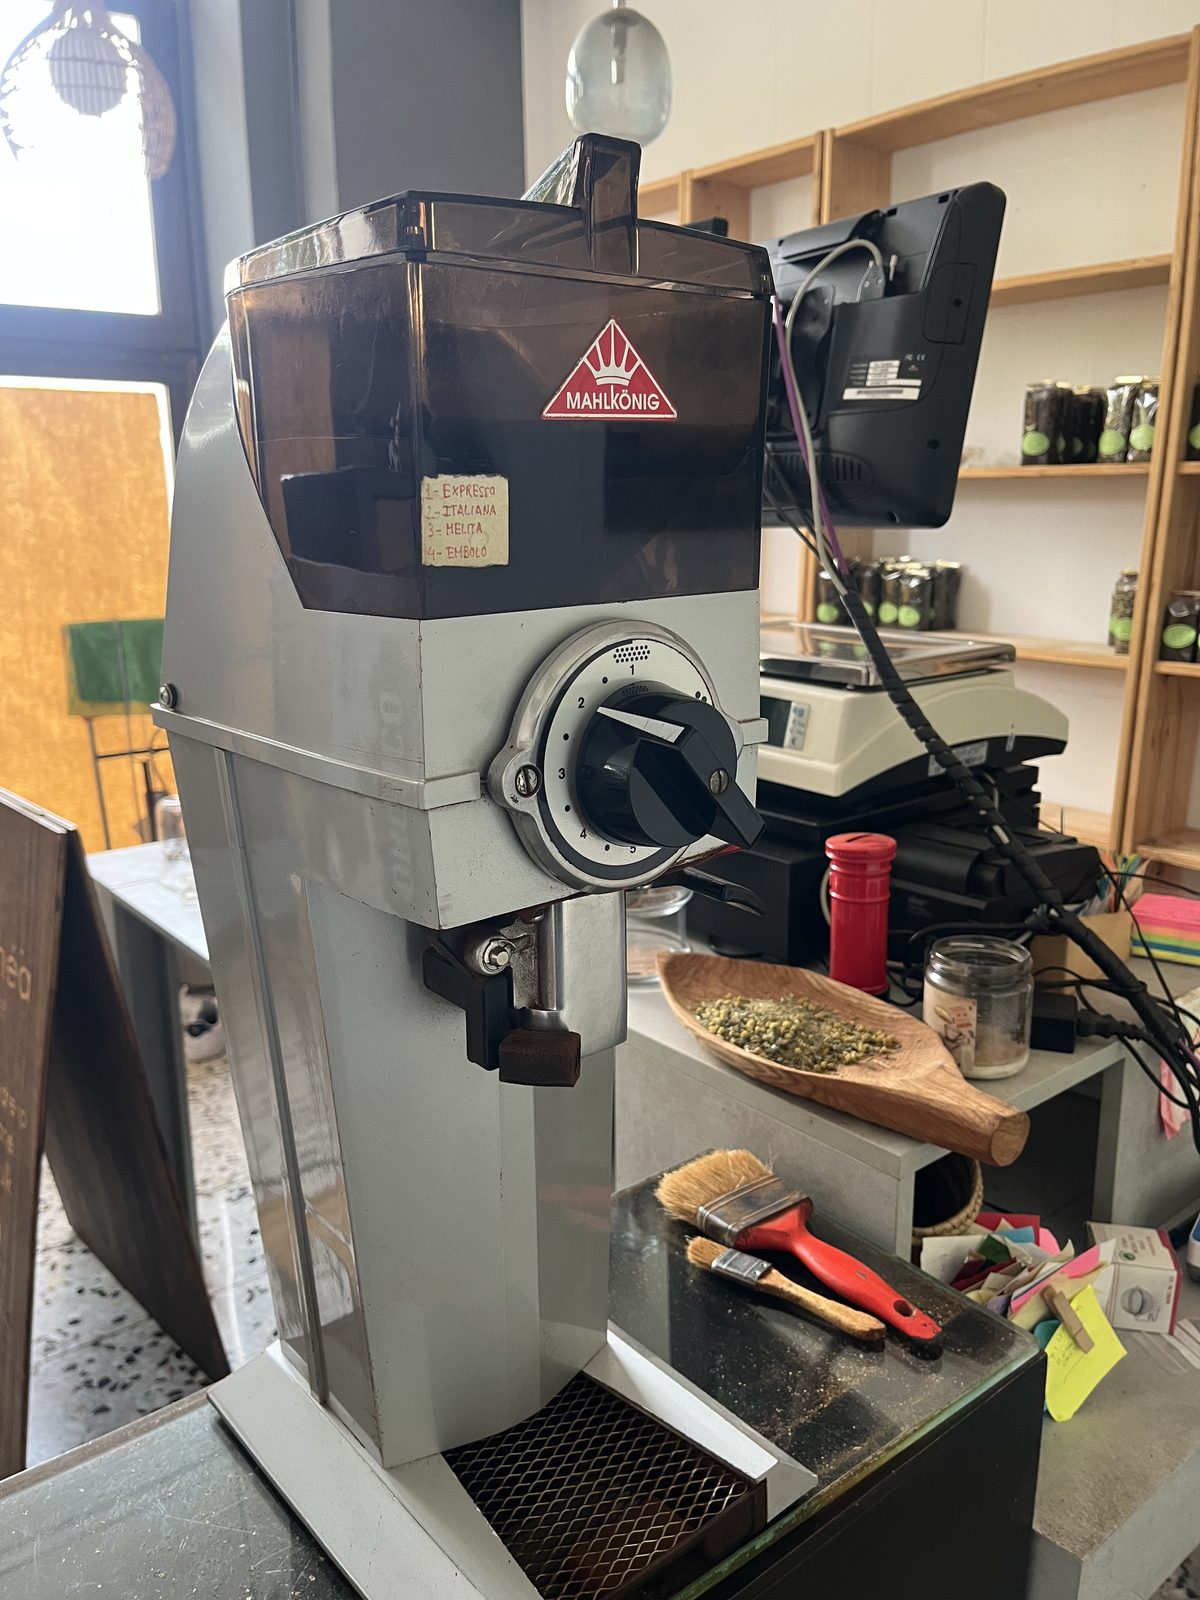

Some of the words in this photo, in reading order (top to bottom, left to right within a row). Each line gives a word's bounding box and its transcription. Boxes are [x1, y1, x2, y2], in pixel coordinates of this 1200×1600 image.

[566, 386, 660, 410] MAHLKÖNIG
[443, 484, 496, 498] EXPRESSO
[443, 504, 497, 517] ITALIANA
[446, 545, 487, 558] EMBOLO
[629, 664, 635, 675] 1
[577, 696, 585, 709] 2
[558, 767, 566, 780] 3
[579, 828, 588, 839] 4
